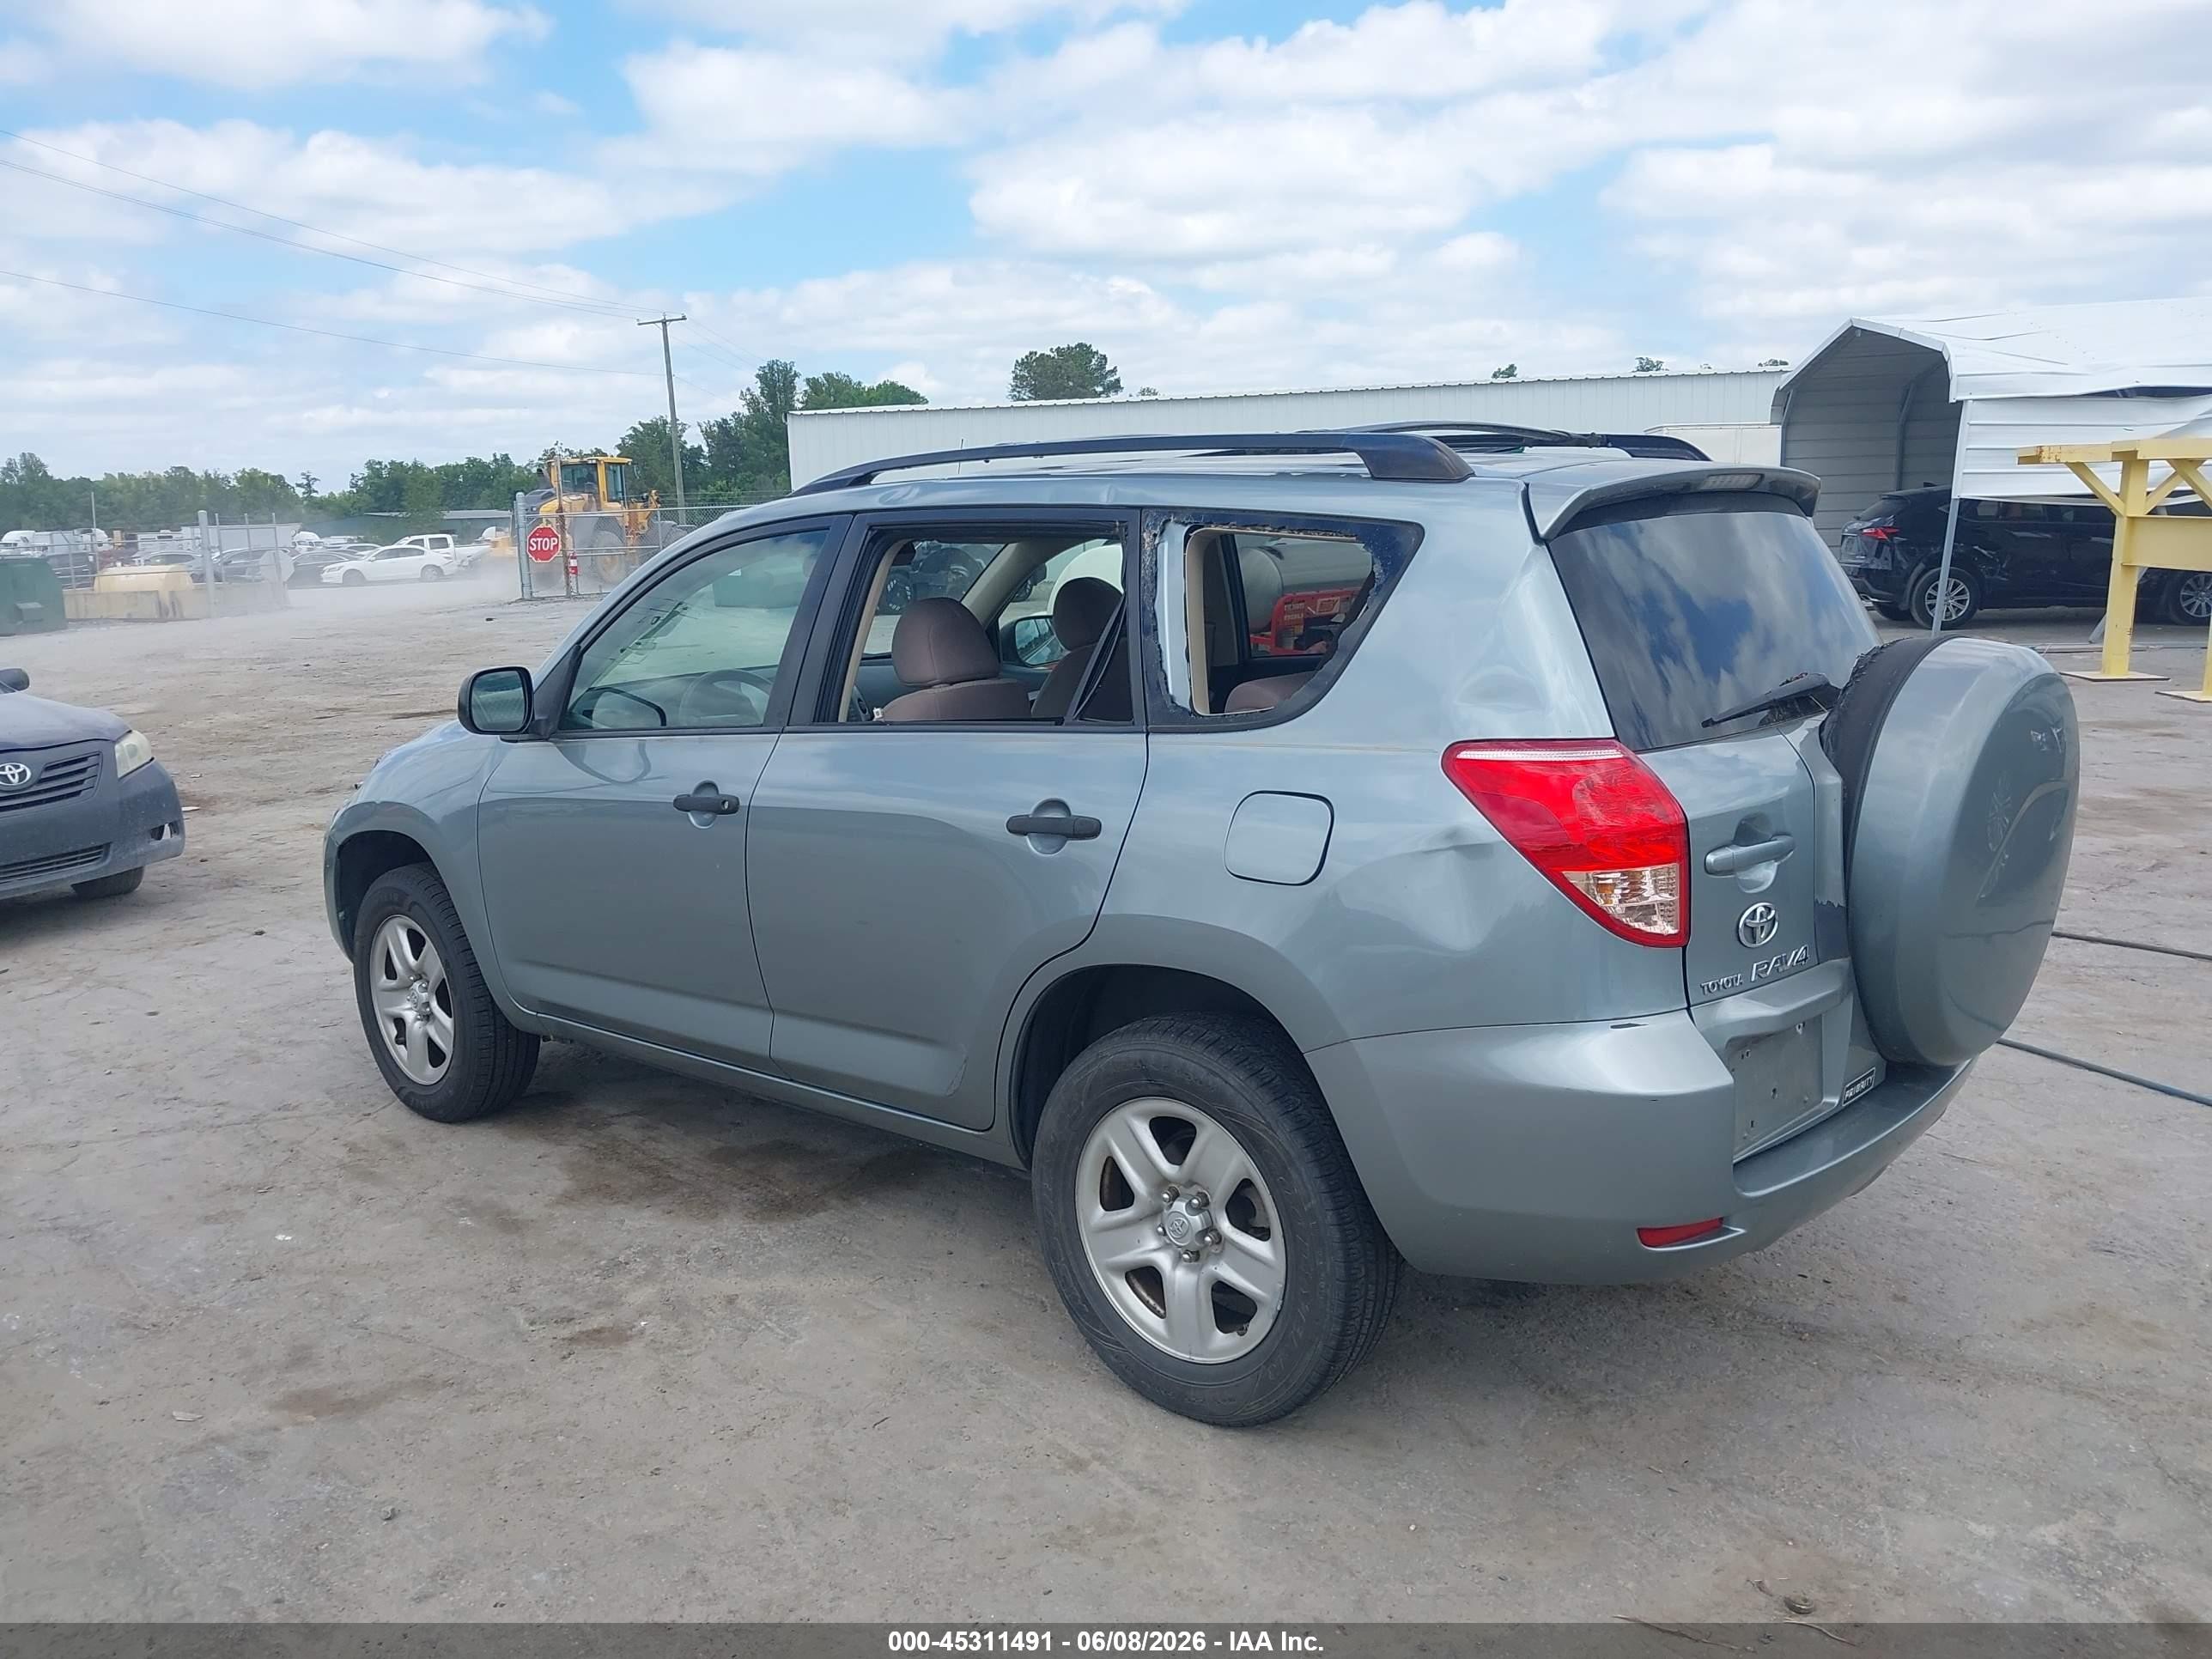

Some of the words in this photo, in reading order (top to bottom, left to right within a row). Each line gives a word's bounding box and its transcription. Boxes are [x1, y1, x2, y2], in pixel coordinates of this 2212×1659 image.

[529, 537, 558, 551] STOP
[1700, 973, 1743, 995] TOYOTA
[1750, 945, 1809, 982] RAV4
[1844, 1074, 1875, 1101] PRIORITY
